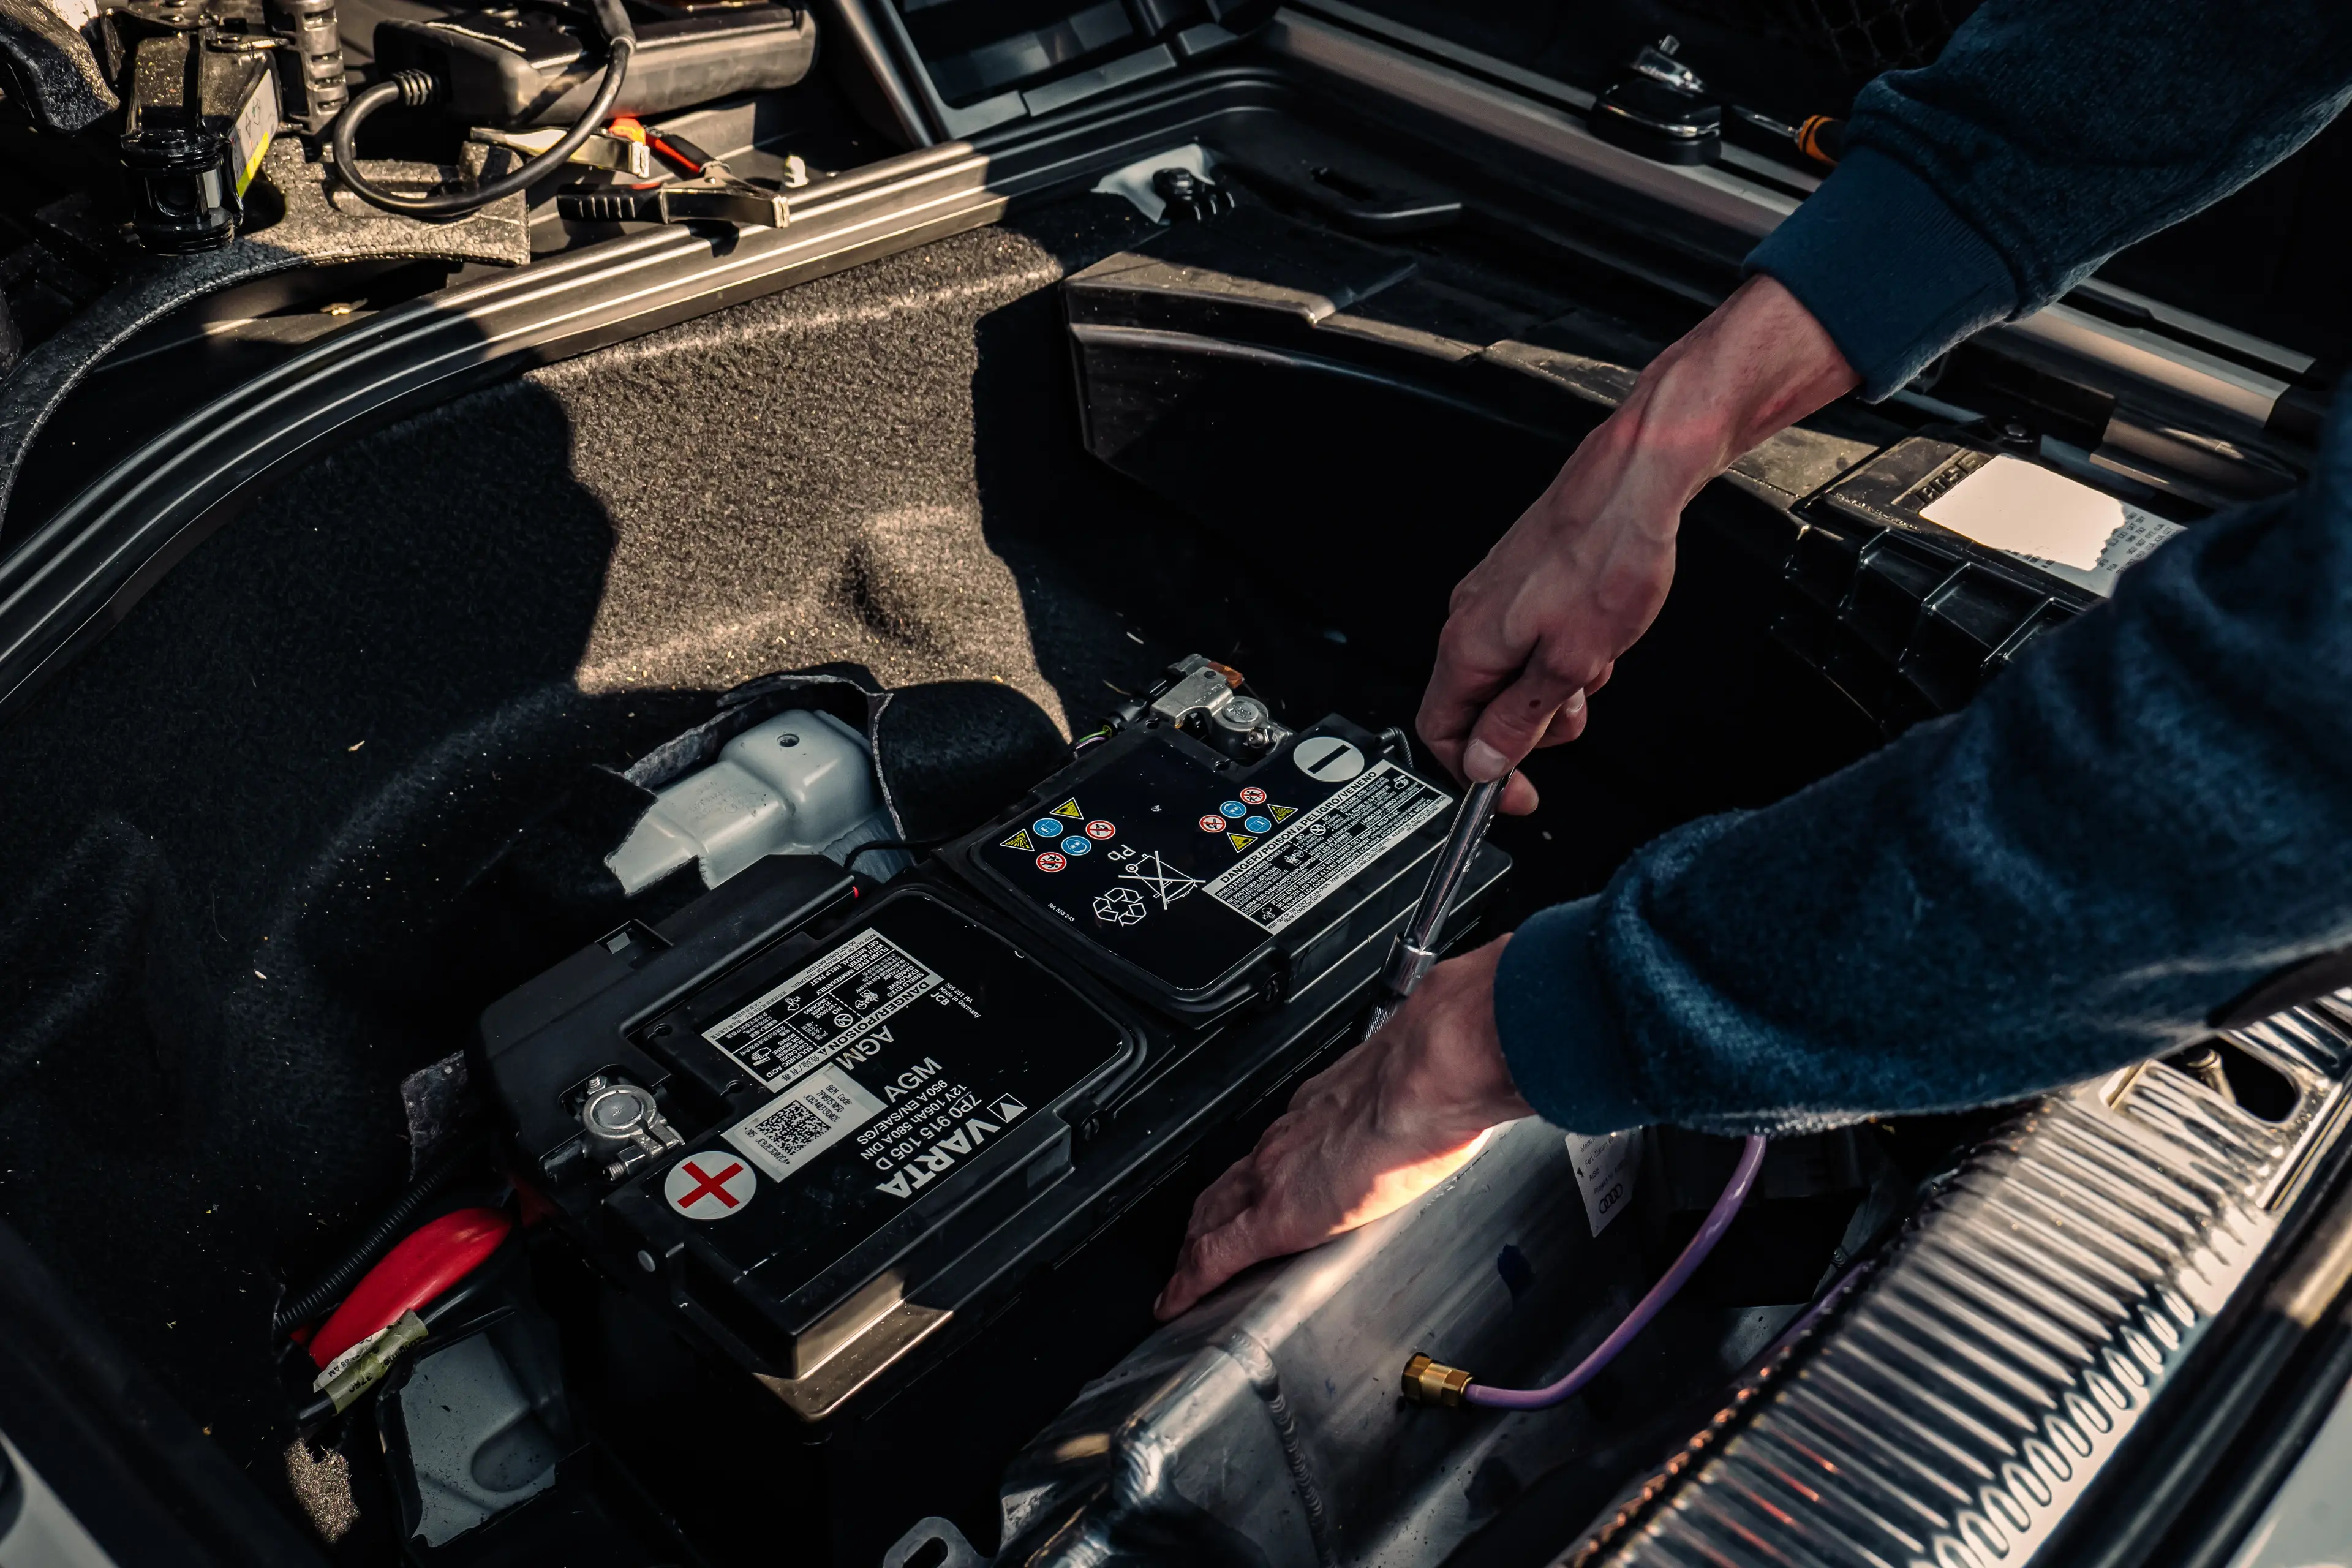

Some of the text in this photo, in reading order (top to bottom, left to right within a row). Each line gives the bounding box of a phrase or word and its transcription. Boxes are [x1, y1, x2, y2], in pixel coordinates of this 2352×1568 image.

[1915, 452, 1981, 503] BOSE
[1363, 785, 1391, 805] SULFURIQUE
[1220, 772, 1377, 883] DANGER/POISON PELIGRO/VENENO
[1321, 845, 1331, 854] LES
[1329, 831, 1351, 848] FLAMMES
[1324, 836, 1335, 845] LES
[1107, 844, 1136, 861] Pb
[1270, 892, 1287, 905] FLUSH
[1285, 884, 1299, 895] EYES
[1297, 863, 1326, 886] IMMEDIATELY
[1324, 855, 1338, 865] WITH
[1336, 845, 1352, 857] WATER
[1359, 826, 1379, 840] MEDICAL
[1377, 817, 1389, 827] HELP
[1387, 810, 1401, 820] FAST.
[1216, 884, 1234, 897] SHIELD
[1232, 876, 1246, 886] EYES
[1243, 859, 1268, 878] EXPLOSIVE
[1267, 850, 1283, 862] GASES
[1281, 892, 1306, 911] ENJUAGUE
[1303, 886, 1314, 895] LOS
[1313, 877, 1326, 888] OJOS
[1324, 851, 1361, 880] INMEDIATAMENTE
[1359, 844, 1370, 853] CON
[1381, 826, 1396, 838] ACUDA
[1232, 880, 1258, 899] PROTEGER
[1256, 874, 1267, 883] LES
[1264, 865, 1278, 876] YEUX
[1240, 857, 1316, 912] CUBRA SUS OJOS GASES EXPLOSIVOS
[1282, 889, 1301, 903] RINCER
[1298, 883, 1310, 891] LES
[1307, 874, 1322, 884] YEUX
[1322, 862, 1338, 873] L'EAU
[864, 933, 876, 943] KEEP
[825, 952, 840, 961] OPEN
[839, 945, 850, 954] NOT
[847, 944, 885, 968] WITH WATER
[810, 940, 879, 987] GET MEDICAL HELP FAST
[816, 946, 889, 996] FLUSH EYES IMMEDIATELY
[822, 957, 839, 969] REACH
[879, 959, 906, 978] BLINDNESS
[882, 962, 910, 981] CAN CAUSE
[894, 965, 914, 979] GASES
[791, 971, 816, 988] CHILDREN.
[855, 980, 873, 993] INJURY
[886, 972, 924, 998] SHIELD EYES
[887, 968, 919, 991] EXPLOSIVE
[930, 992, 950, 1006] JCB
[938, 986, 954, 998] Made
[957, 1000, 981, 1019] Germany
[944, 982, 973, 1004] 595 251 RA
[803, 998, 827, 1015] SMOKING
[810, 1001, 832, 1016] FLAMES
[815, 1005, 835, 1019] SPARKS
[827, 981, 930, 1050] DANGER/POISON
[832, 1006, 843, 1014] NO
[772, 1041, 793, 1055] SEVERE
[775, 1039, 805, 1058] BLINDNESS
[777, 1033, 797, 1046] BURNS
[835, 1025, 894, 1071] AGM
[766, 1046, 813, 1077] SULFURIC ACID
[779, 1042, 809, 1063] CAN CAUSE
[781, 1054, 820, 1082] 危险/有毒
[884, 1057, 943, 1103] AGM
[826, 1084, 851, 1106] BEM Code
[944, 1084, 967, 1102] 12V
[857, 1099, 920, 1145] EN/SAE/GS
[910, 1099, 946, 1123] 105Ah
[875, 1094, 982, 1170] 7P0 915 105 D
[860, 1142, 885, 1160] DIN
[876, 1118, 1000, 1198] VARTA
[328, 1367, 341, 1378] AM
